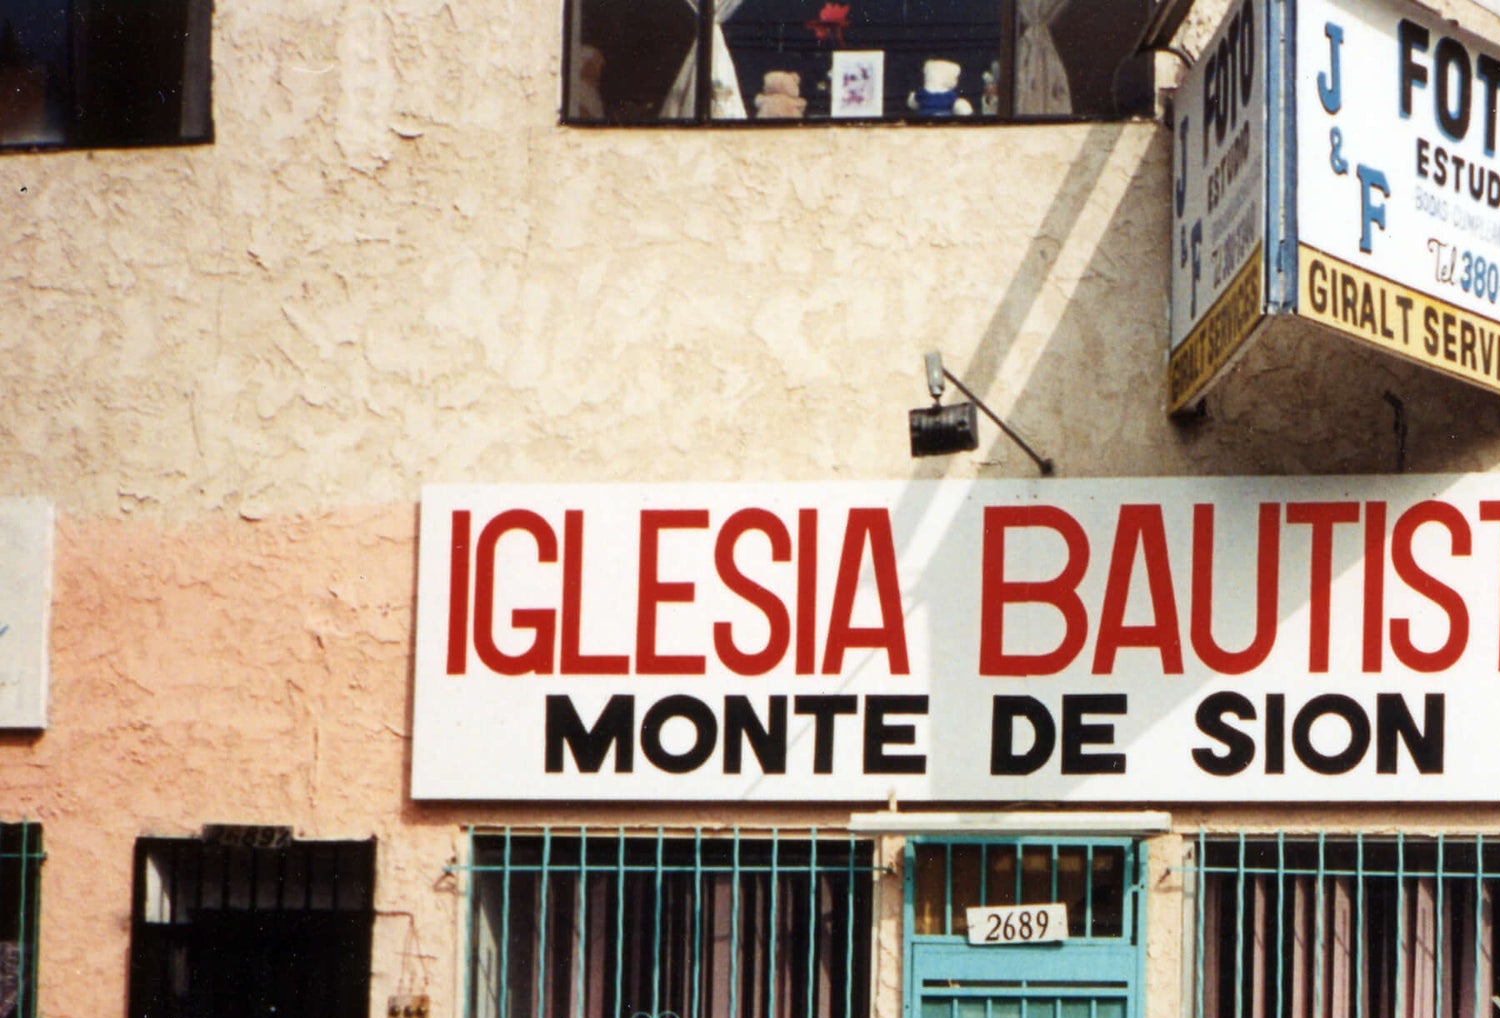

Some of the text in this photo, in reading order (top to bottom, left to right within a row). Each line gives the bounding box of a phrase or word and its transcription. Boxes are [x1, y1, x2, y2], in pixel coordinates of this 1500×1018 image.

[1316, 22, 1391, 253] J & F
[1308, 260, 1413, 345] GIRALT
[446, 507, 910, 676] IGLESIA
[545, 690, 1446, 777] MONTE DE SION
[985, 910, 1049, 942] 2689
